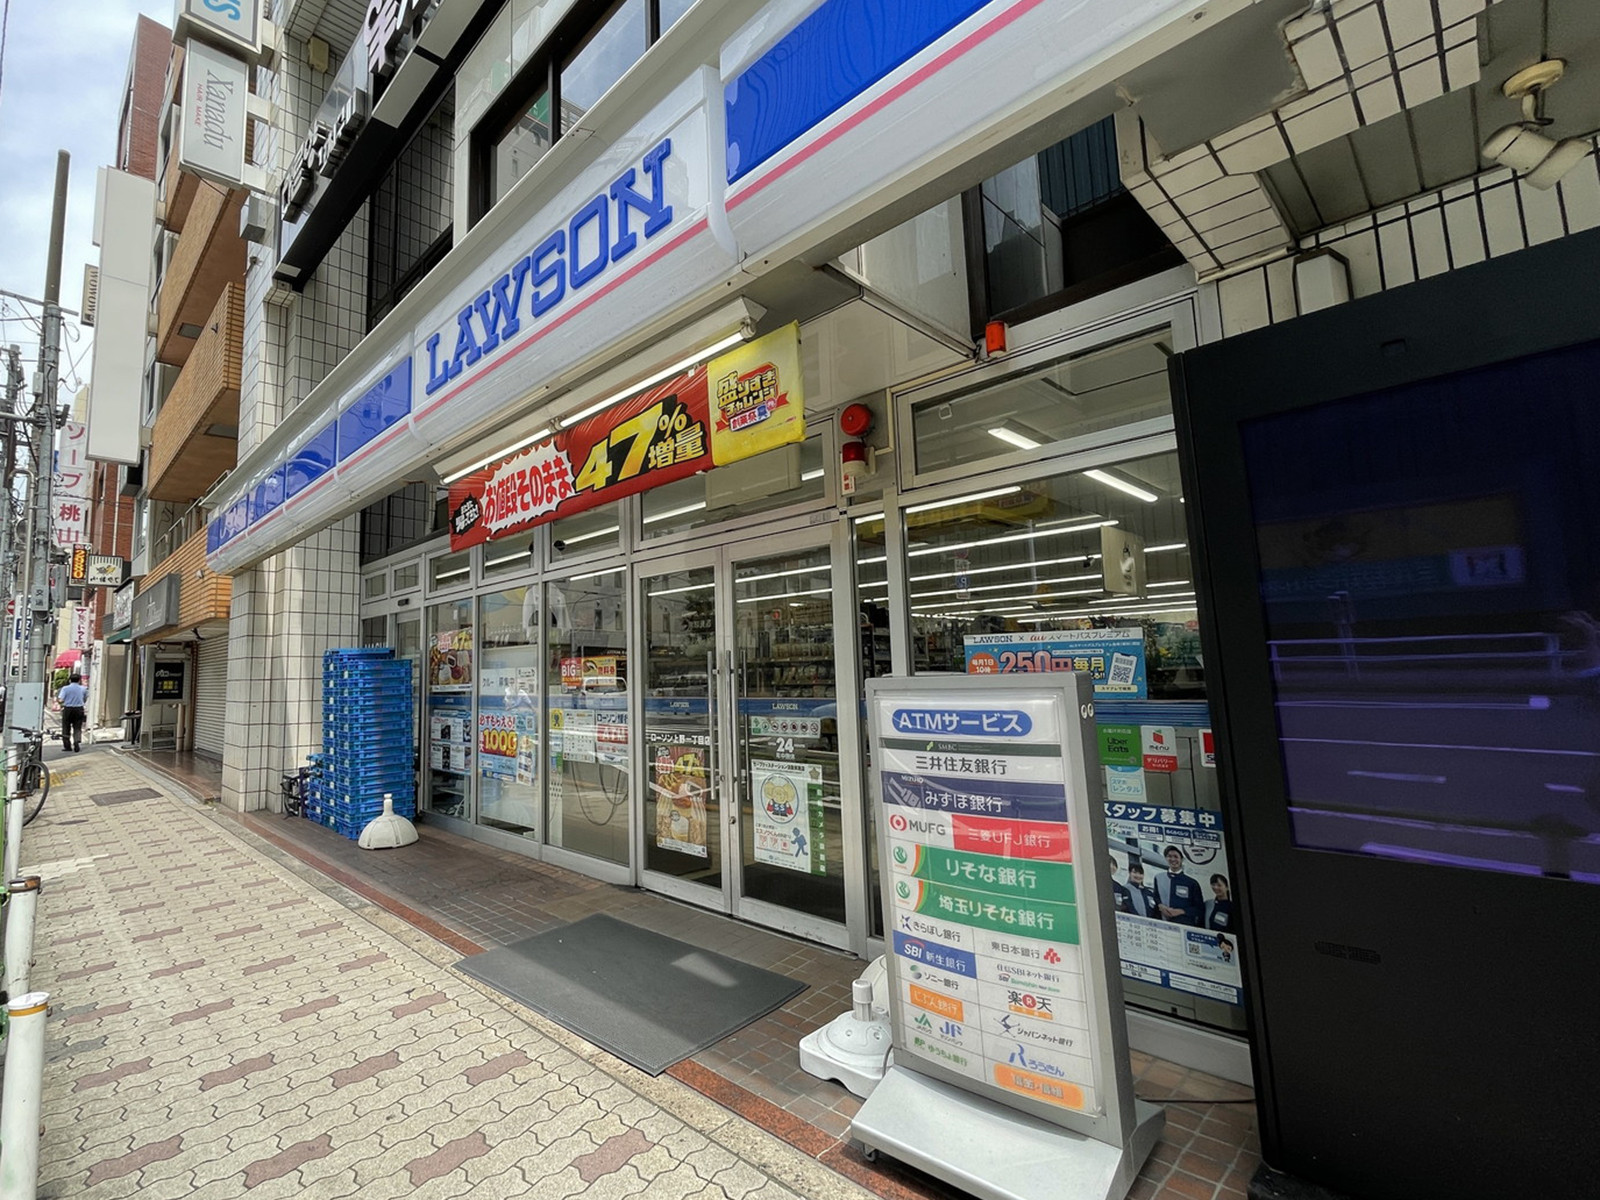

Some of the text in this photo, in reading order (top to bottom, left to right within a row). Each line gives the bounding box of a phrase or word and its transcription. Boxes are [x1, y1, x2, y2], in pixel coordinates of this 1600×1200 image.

[203, 69, 234, 151] Xanadu
[426, 138, 673, 395] LAWSON
[718, 368, 776, 407] 盛りすぎ
[575, 402, 687, 492] 47%
[648, 426, 704, 468] 増量
[484, 456, 572, 526] お値段そのまま
[973, 635, 1013, 643] LAWSON
[1074, 657, 1104, 673] 毎月
[899, 712, 1023, 733] ATMサービス
[776, 737, 795, 753] 24
[1107, 737, 1128, 745] Uber
[1108, 744, 1129, 753] Eats
[915, 755, 1007, 775] 三井住友銀行
[924, 790, 1003, 813] みずほ銀行
[909, 819, 946, 836] MUFG
[967, 828, 1051, 848] 三菱UFJ銀行
[945, 857, 1037, 889] りそな銀行
[939, 894, 1054, 930] 埼玉りそな銀行
[913, 920, 961, 943] きらぼし銀行
[903, 944, 967, 973] SBI 新生銀行
[1028, 1058, 1065, 1077] ろうきん
